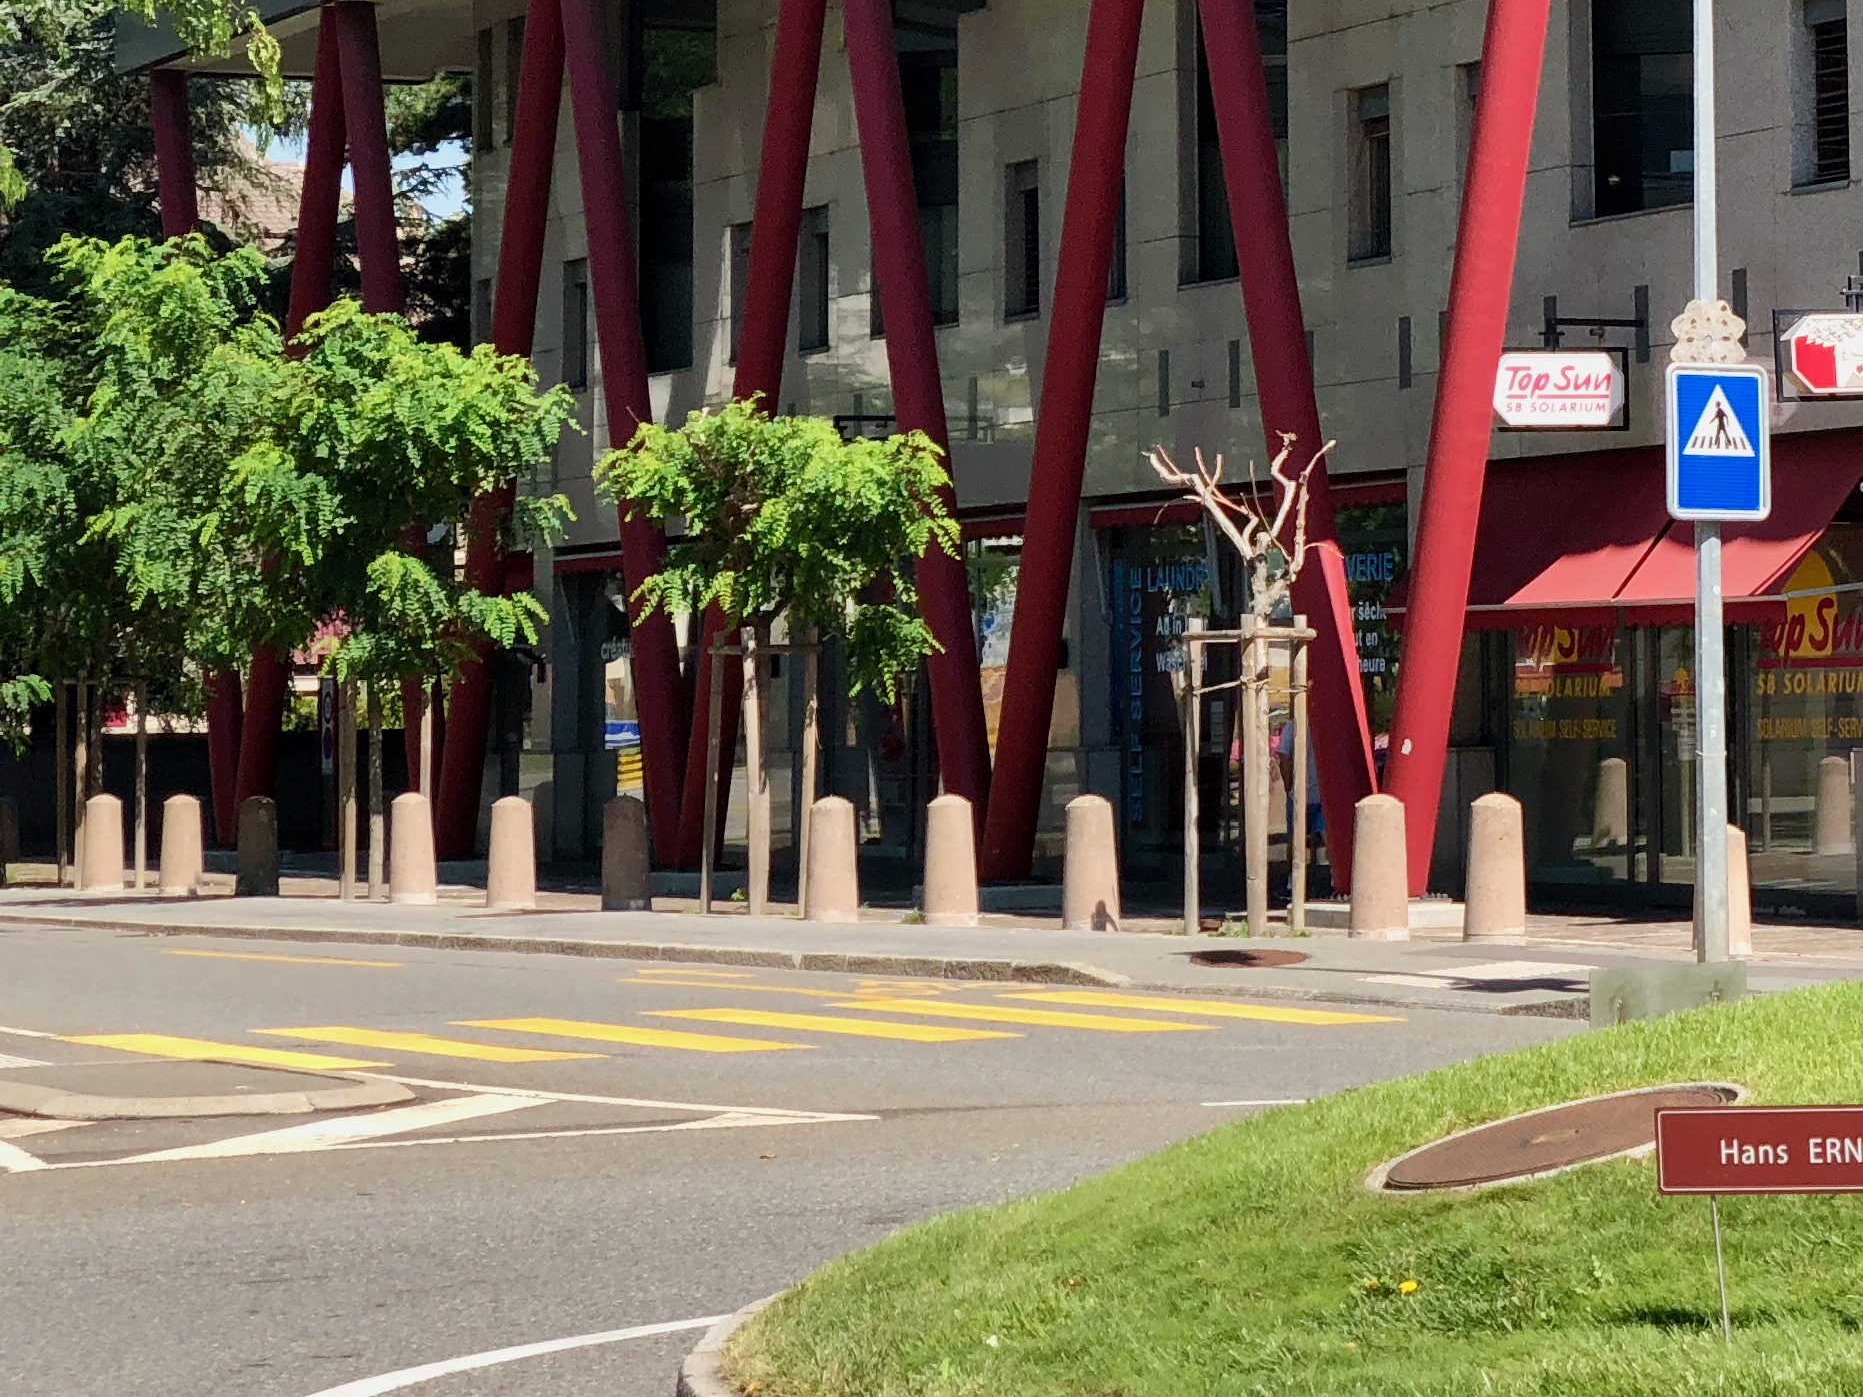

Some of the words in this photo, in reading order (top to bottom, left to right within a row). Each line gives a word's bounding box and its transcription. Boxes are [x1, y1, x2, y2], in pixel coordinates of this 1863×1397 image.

[1504, 366, 1550, 399] Top
[1552, 365, 1612, 392] Sun
[1530, 401, 1606, 413] SOLARIUM
[1129, 567, 1143, 721] SERVICE
[1757, 673, 1777, 696] SB
[1756, 717, 1805, 739] SOLARIUM
[1720, 1138, 1789, 1165] Hans
